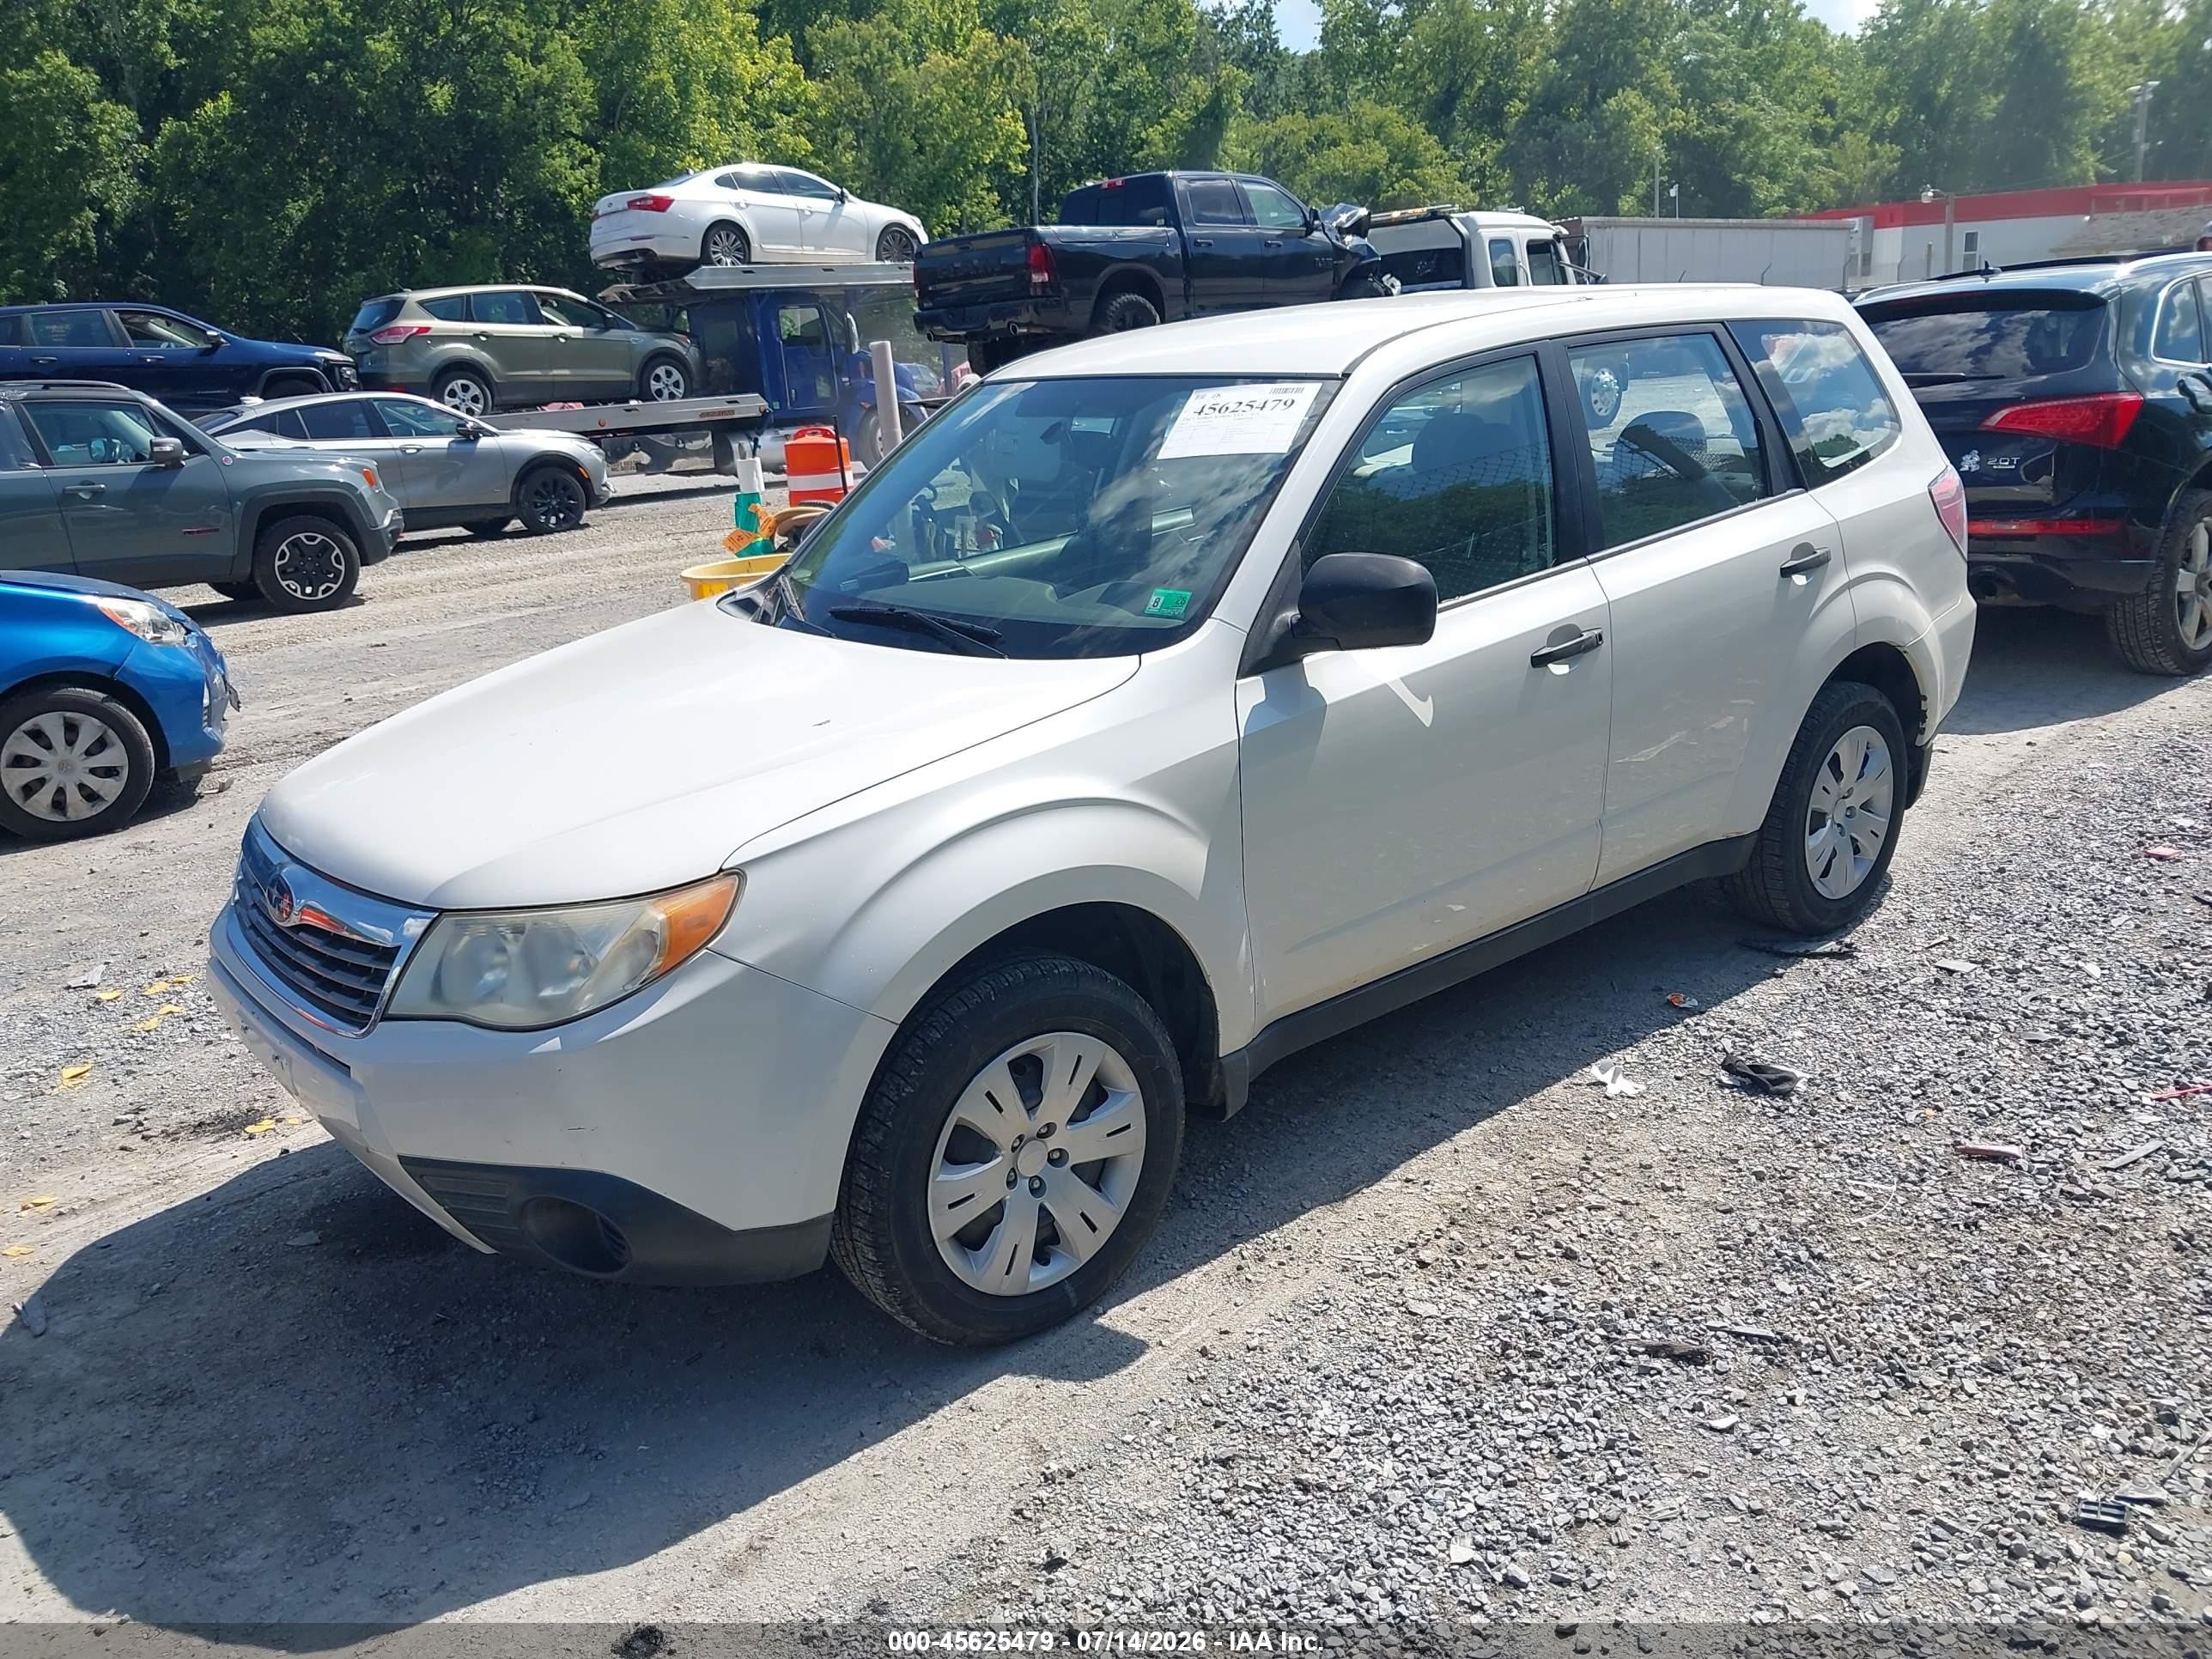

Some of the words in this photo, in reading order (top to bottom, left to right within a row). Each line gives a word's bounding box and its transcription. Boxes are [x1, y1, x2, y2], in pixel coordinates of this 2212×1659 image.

[1193, 398, 1295, 416] 45625479
[1152, 598, 1161, 607] 8
[1176, 597, 1187, 605] 26
